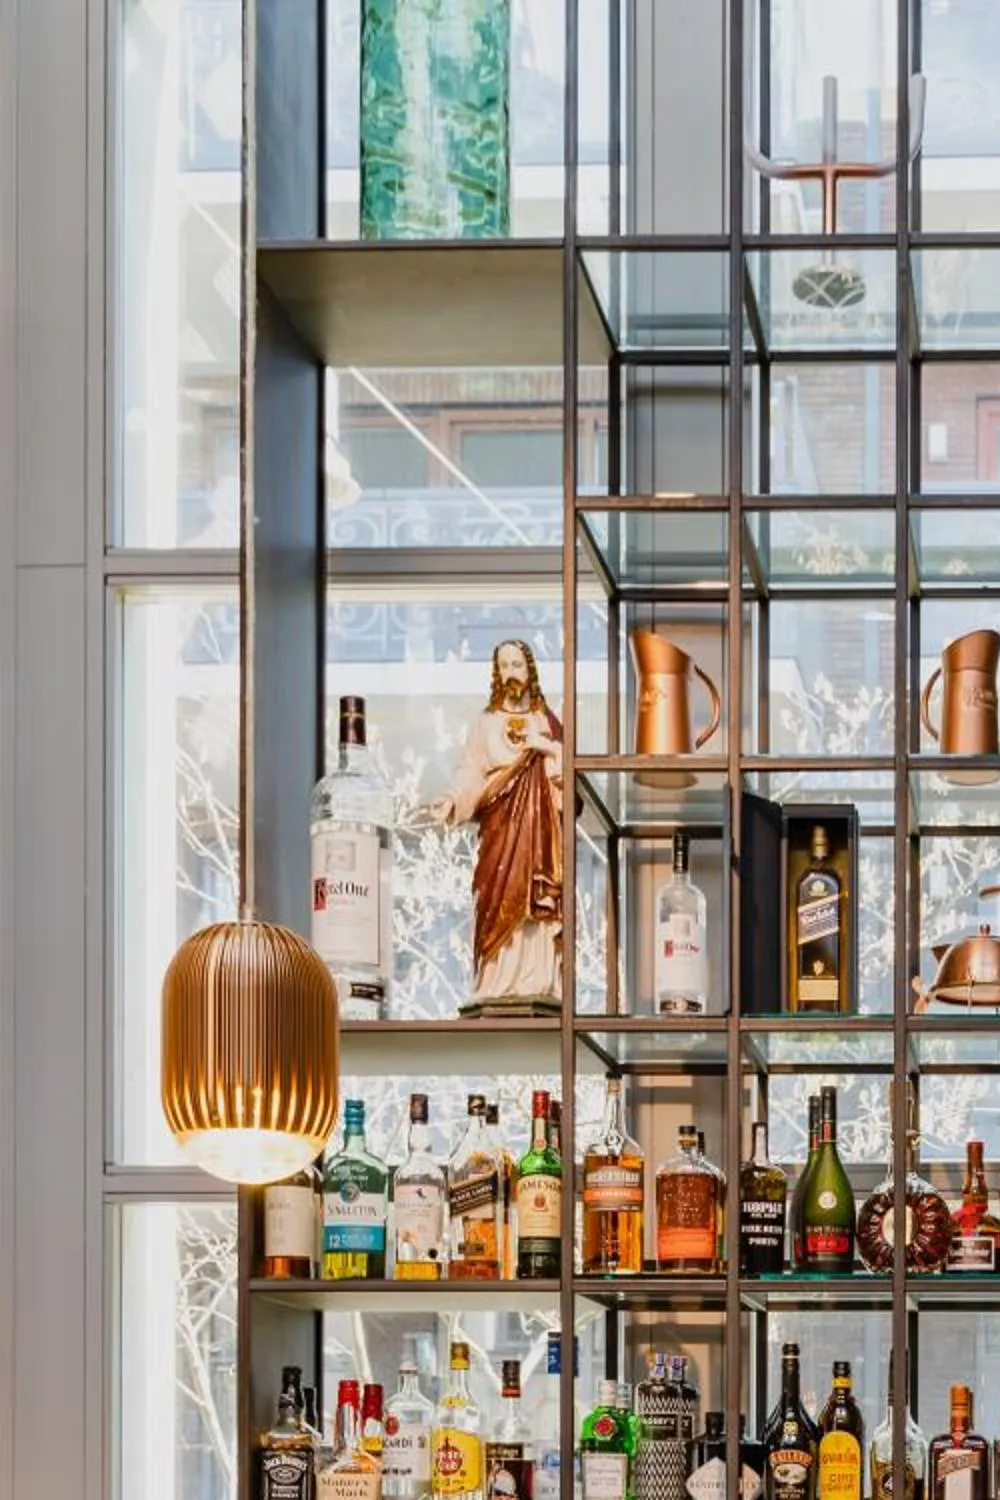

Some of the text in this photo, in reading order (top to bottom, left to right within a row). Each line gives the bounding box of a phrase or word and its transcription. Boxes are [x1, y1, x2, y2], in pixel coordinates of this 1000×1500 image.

[345, 879, 369, 898] One
[321, 1477, 369, 1487] Maker's
[336, 1488, 368, 1497] Mark
